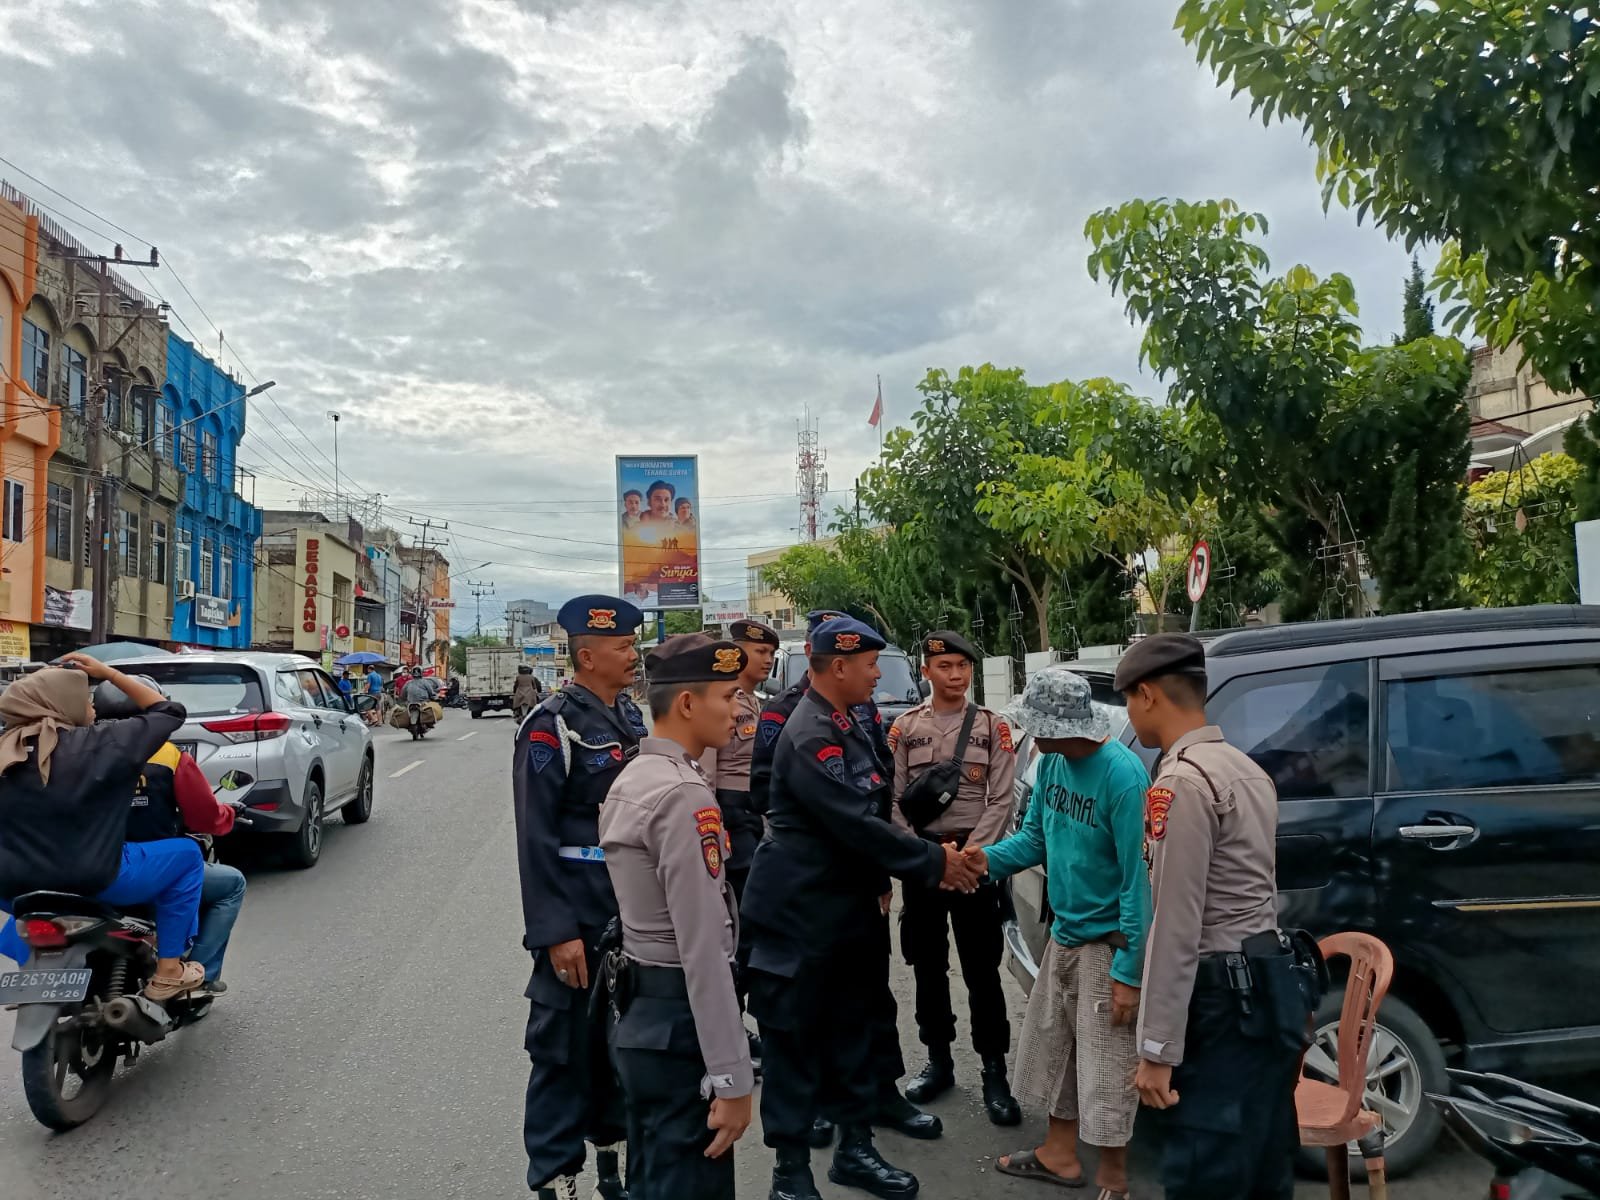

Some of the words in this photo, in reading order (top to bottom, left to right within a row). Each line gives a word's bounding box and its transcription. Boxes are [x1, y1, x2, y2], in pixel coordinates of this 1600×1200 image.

[660, 565, 698, 582] Surya
[303, 538, 320, 633] BEGADANG
[1151, 789, 1172, 799] POLDA
[1, 974, 19, 988] BE
[20, 972, 57, 986] 2679
